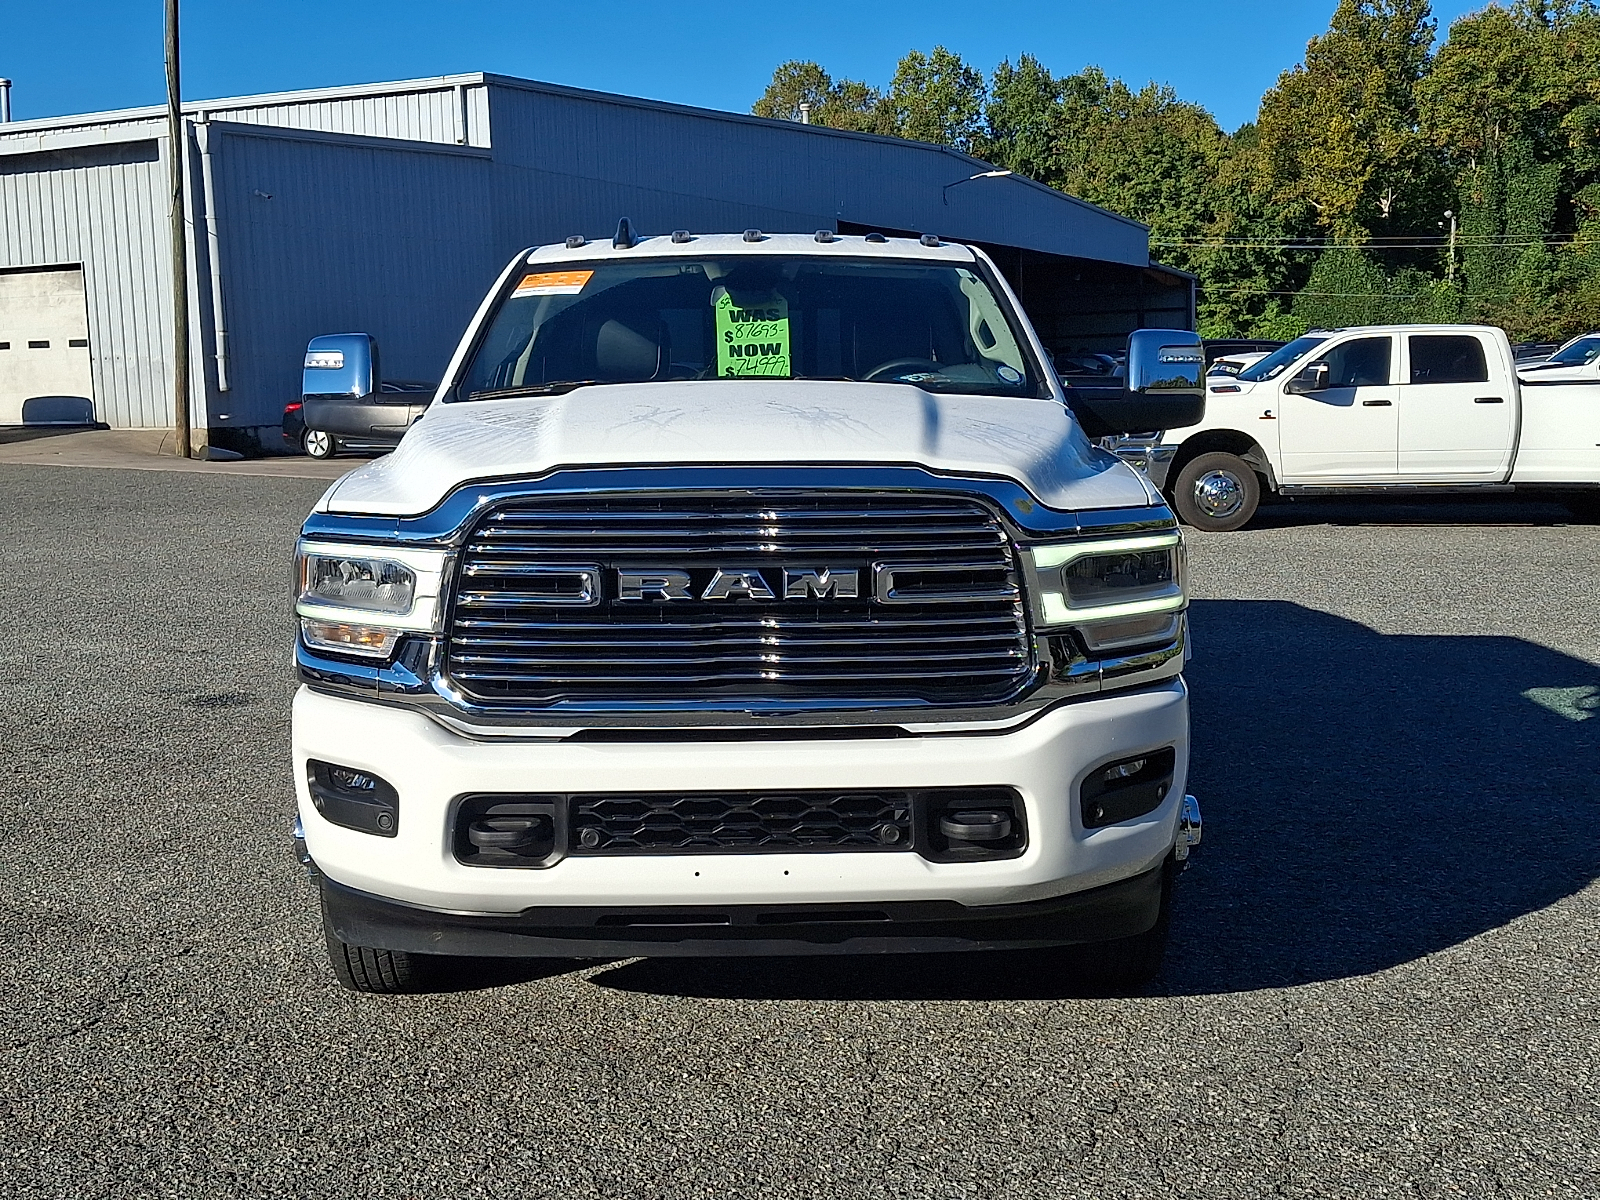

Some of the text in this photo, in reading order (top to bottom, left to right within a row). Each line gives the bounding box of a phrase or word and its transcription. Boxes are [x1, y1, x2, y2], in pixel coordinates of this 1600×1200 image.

[728, 308, 780, 323] WAS
[729, 343, 782, 357] NOW
[617, 566, 859, 600] RAM
